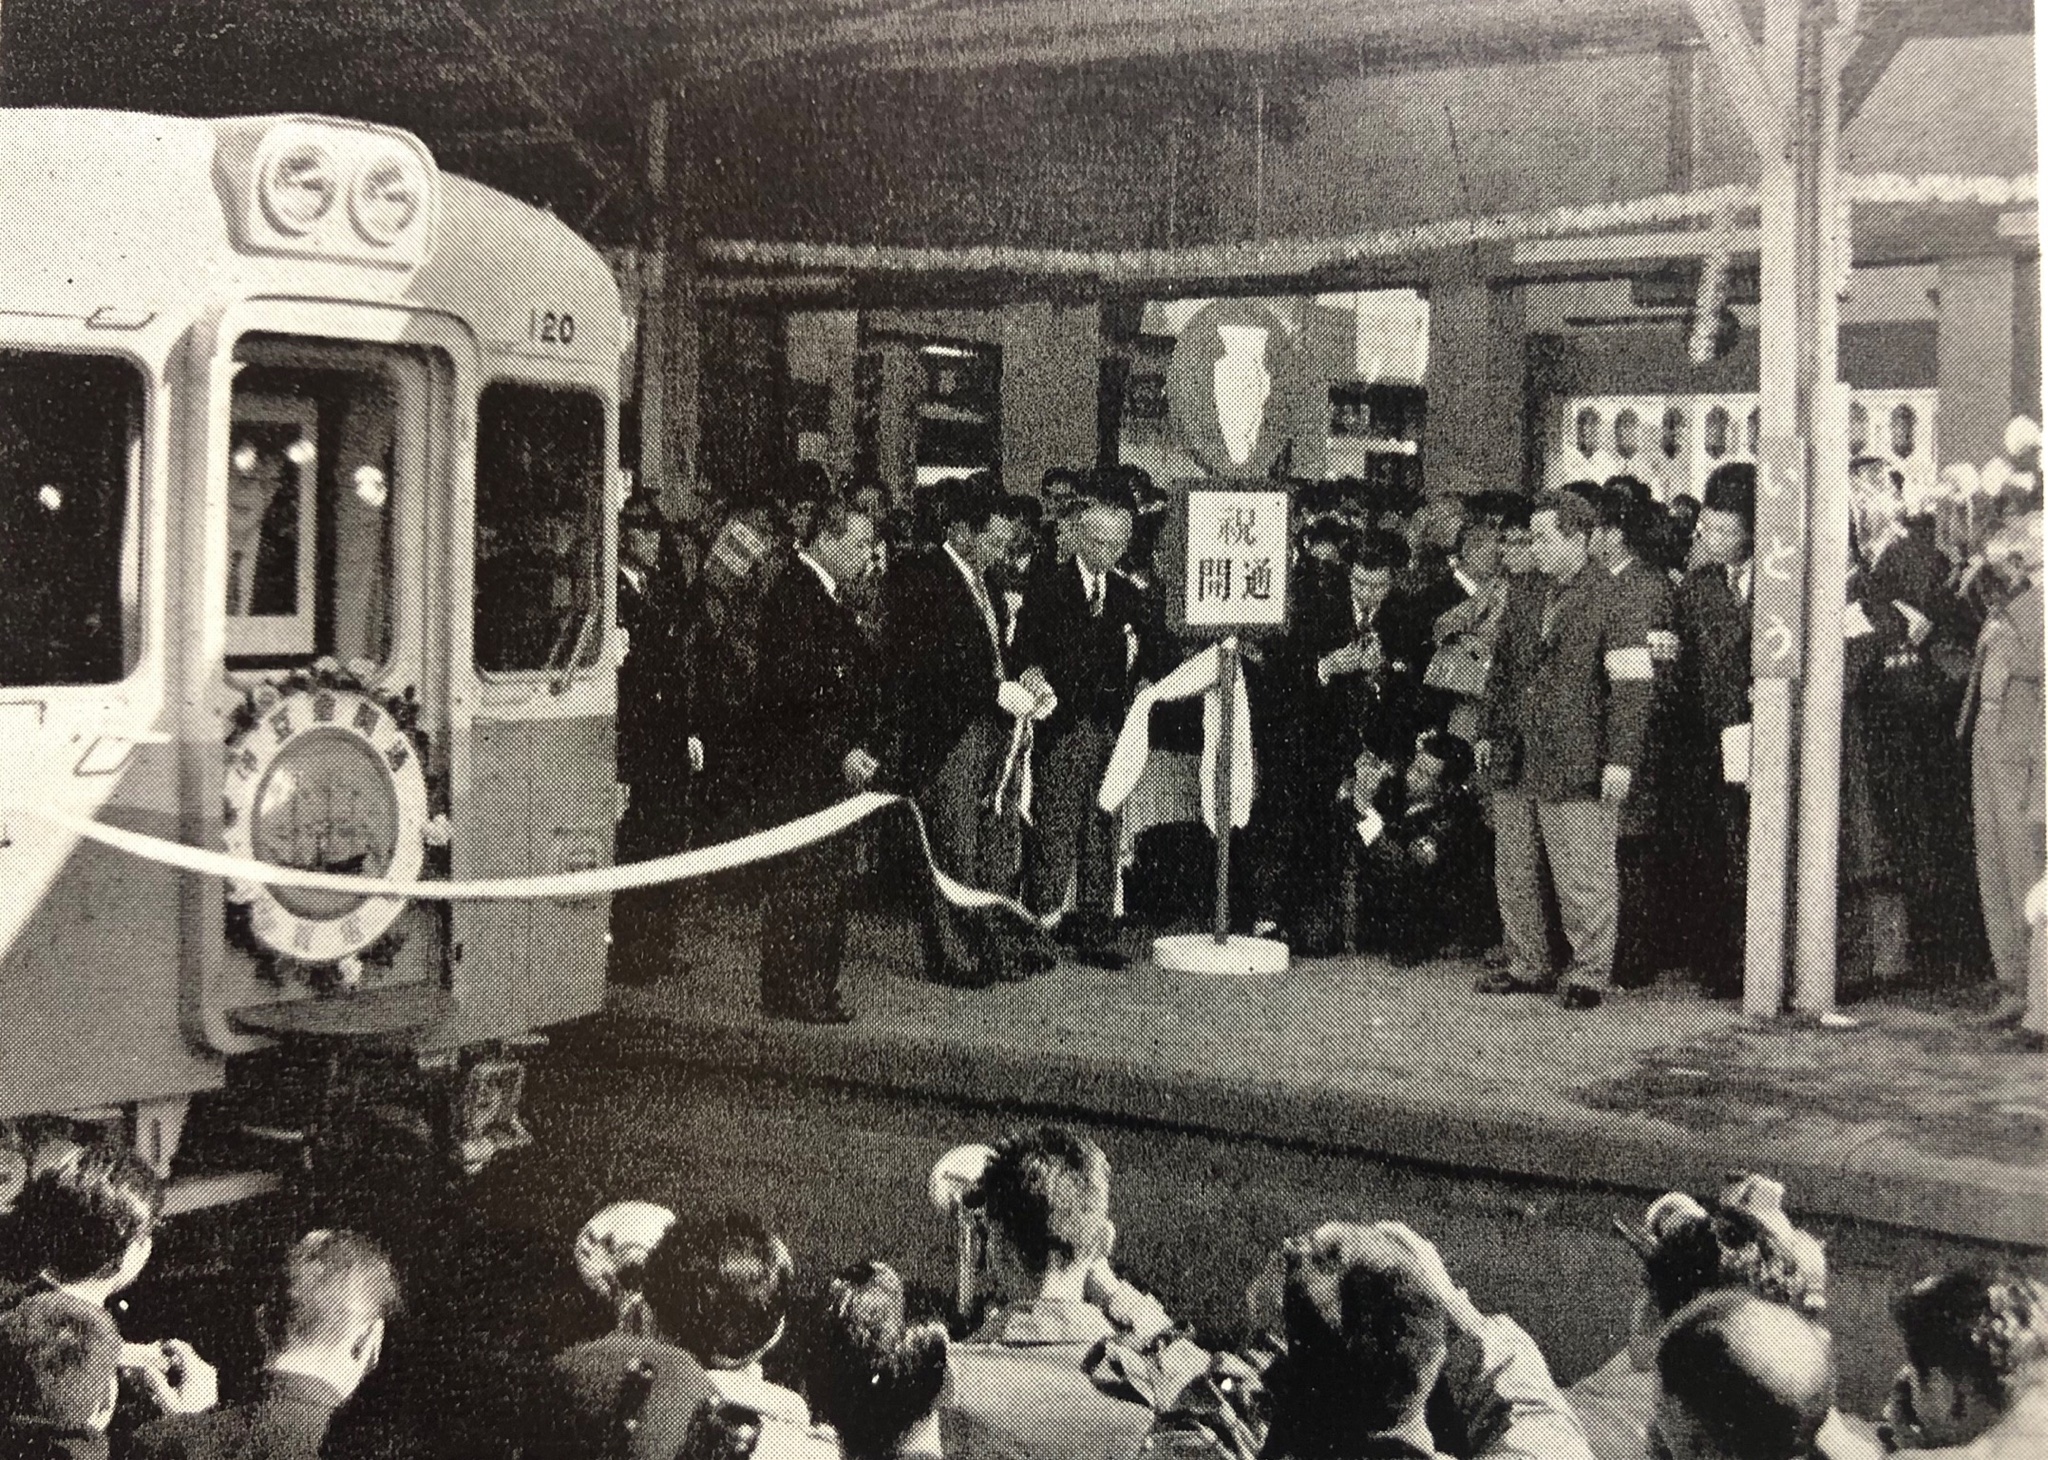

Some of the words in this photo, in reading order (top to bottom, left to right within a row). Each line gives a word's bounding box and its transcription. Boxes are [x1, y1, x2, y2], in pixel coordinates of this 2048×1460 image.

[529, 306, 575, 345] 120
[1217, 504, 1258, 547] 祝
[1198, 556, 1272, 603] 開通
[1760, 461, 1800, 661] いとう
